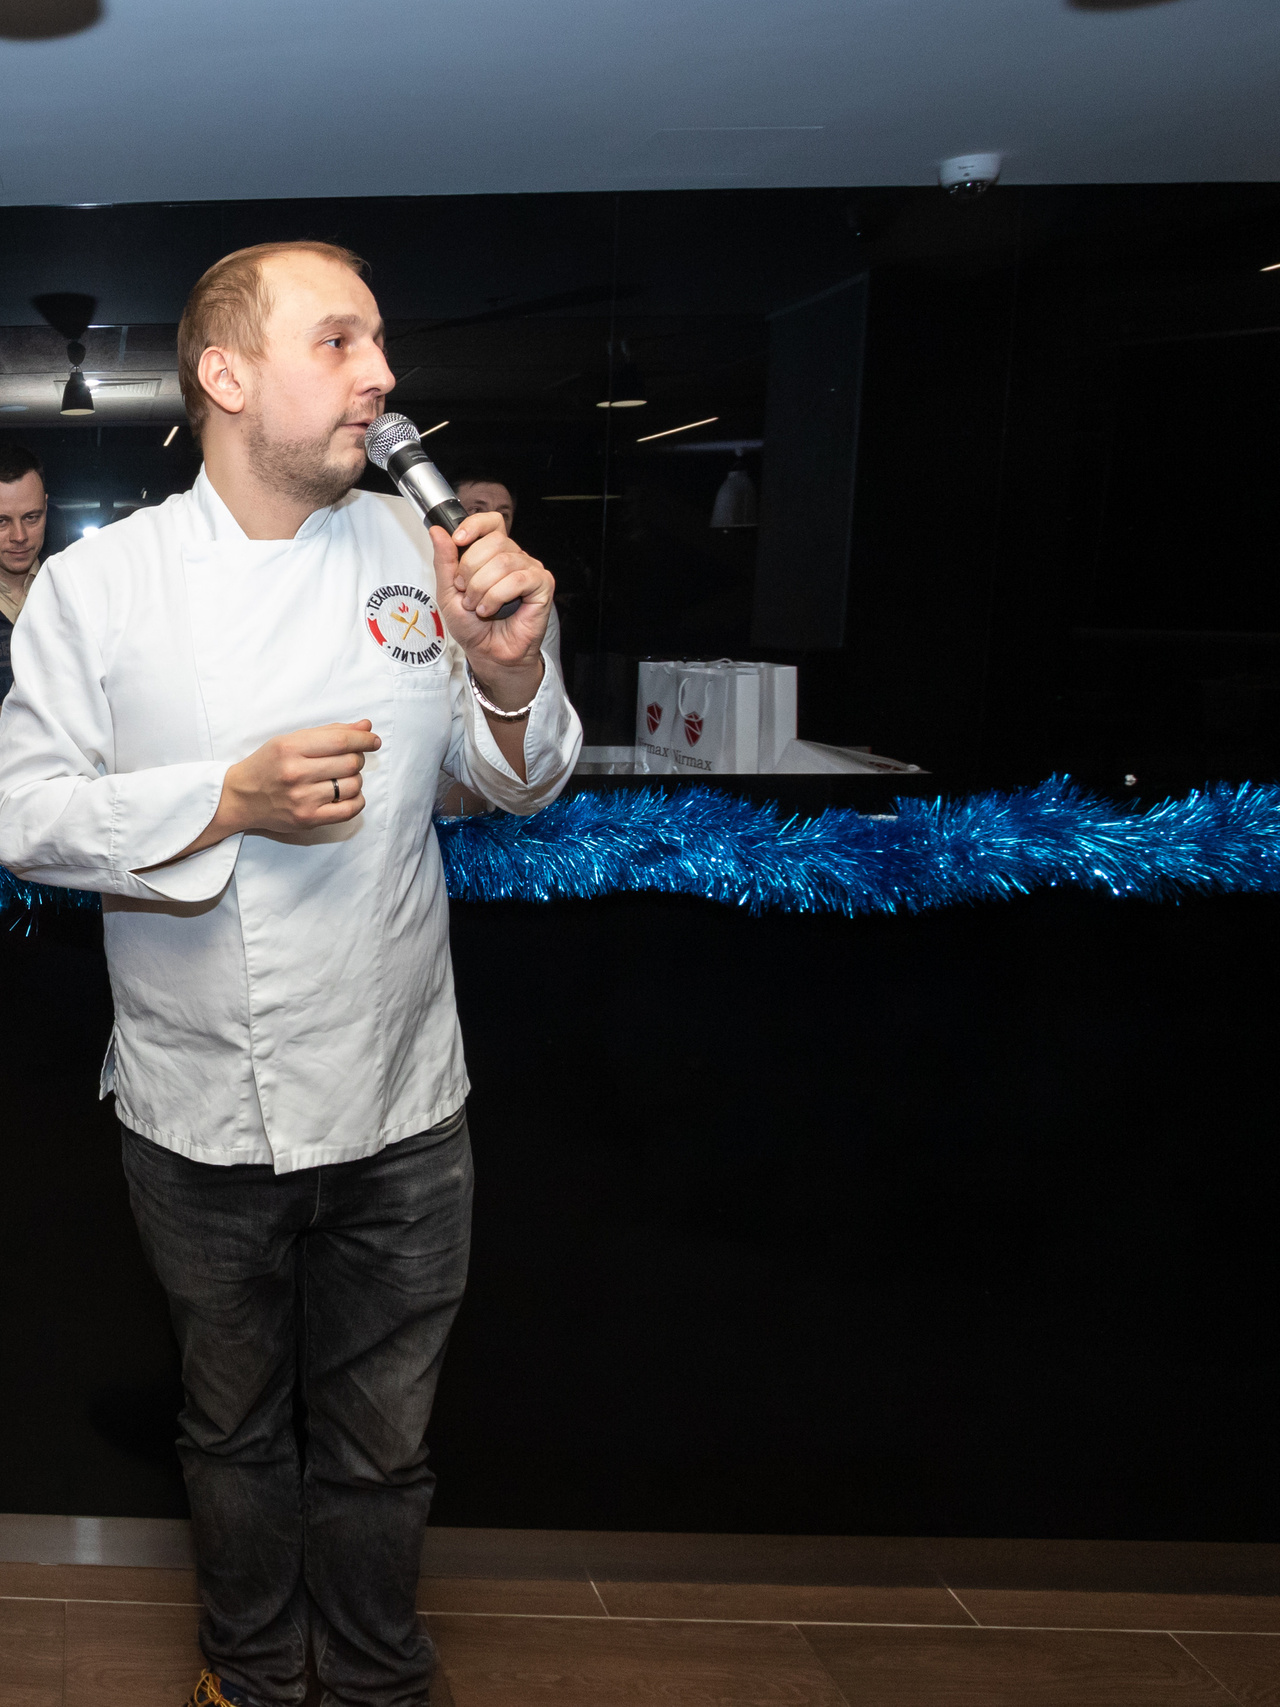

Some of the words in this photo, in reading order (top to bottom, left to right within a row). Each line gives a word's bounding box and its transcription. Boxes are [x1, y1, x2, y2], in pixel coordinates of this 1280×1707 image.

[367, 585, 430, 610] ТЕХНОЛОГИИ
[392, 642, 442, 664] ПИТАНИЯ
[672, 749, 712, 771] Nirmax
